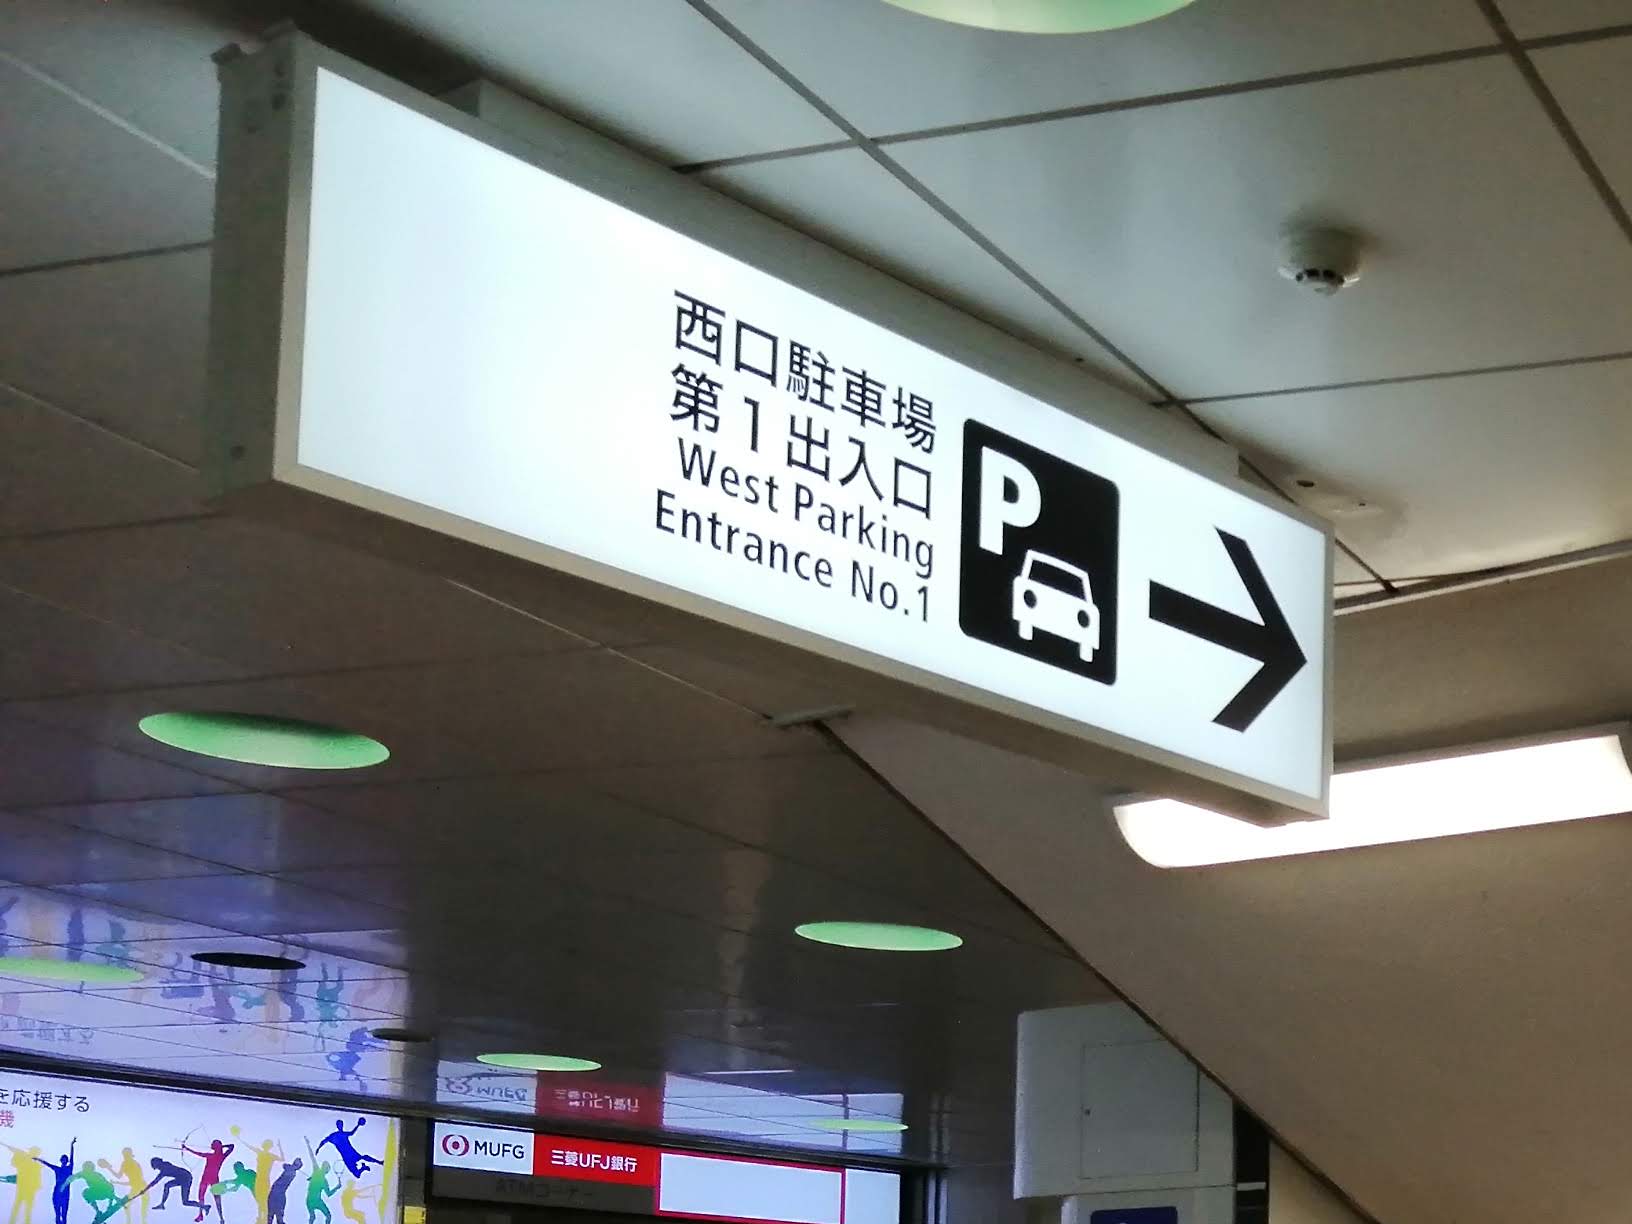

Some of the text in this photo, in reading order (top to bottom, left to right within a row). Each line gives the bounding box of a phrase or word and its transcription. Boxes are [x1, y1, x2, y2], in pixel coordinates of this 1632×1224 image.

[674, 290, 937, 454] 西口駐車場
[670, 363, 932, 520] 第1出入口
[678, 437, 935, 580] West Parking
[656, 489, 930, 623] Entrance No.1
[474, 1140, 525, 1159] MUFG
[551, 1150, 638, 1173] 三菱UFJ銀行
